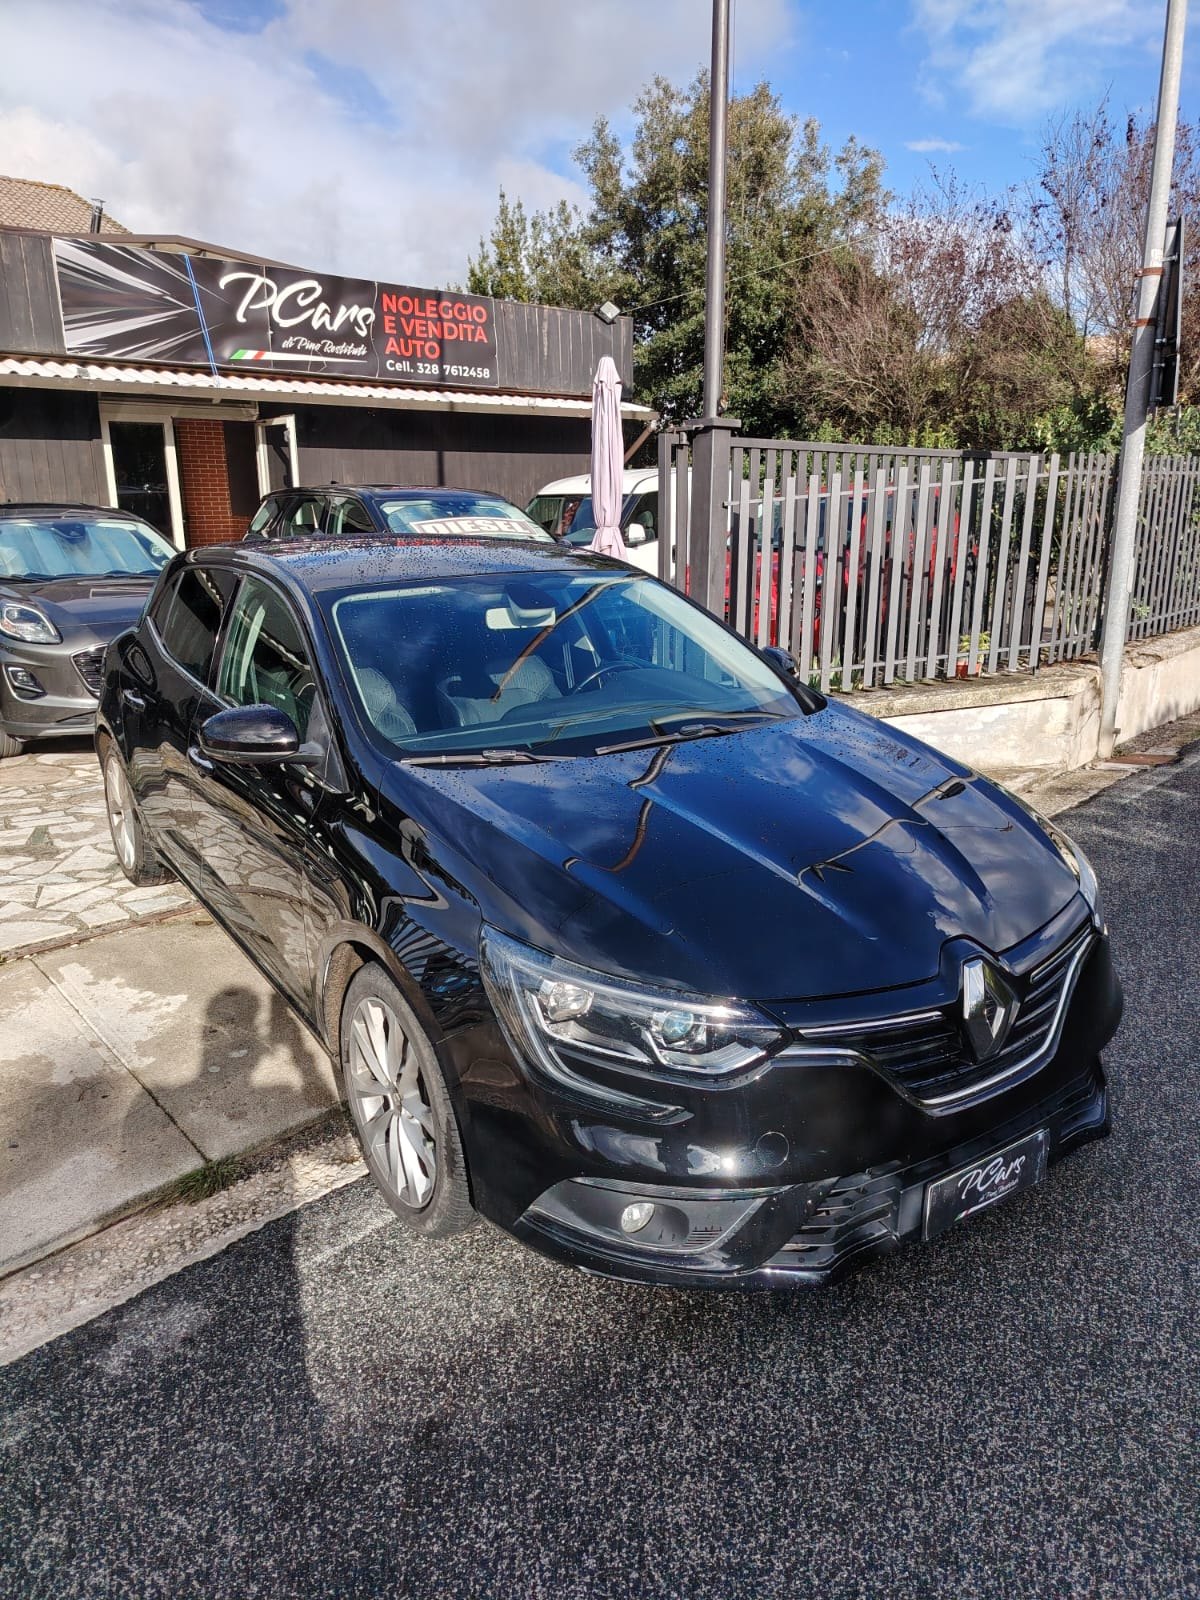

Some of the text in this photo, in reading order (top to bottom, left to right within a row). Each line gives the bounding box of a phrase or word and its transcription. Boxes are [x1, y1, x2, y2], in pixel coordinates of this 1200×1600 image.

[382, 293, 487, 323] NOLEGGIO
[383, 316, 488, 343] E VENDITA
[281, 336, 295, 349] di
[385, 336, 441, 360] AUTO
[386, 359, 490, 379] Cell. 328 7612458
[421, 519, 532, 534] DIESEL
